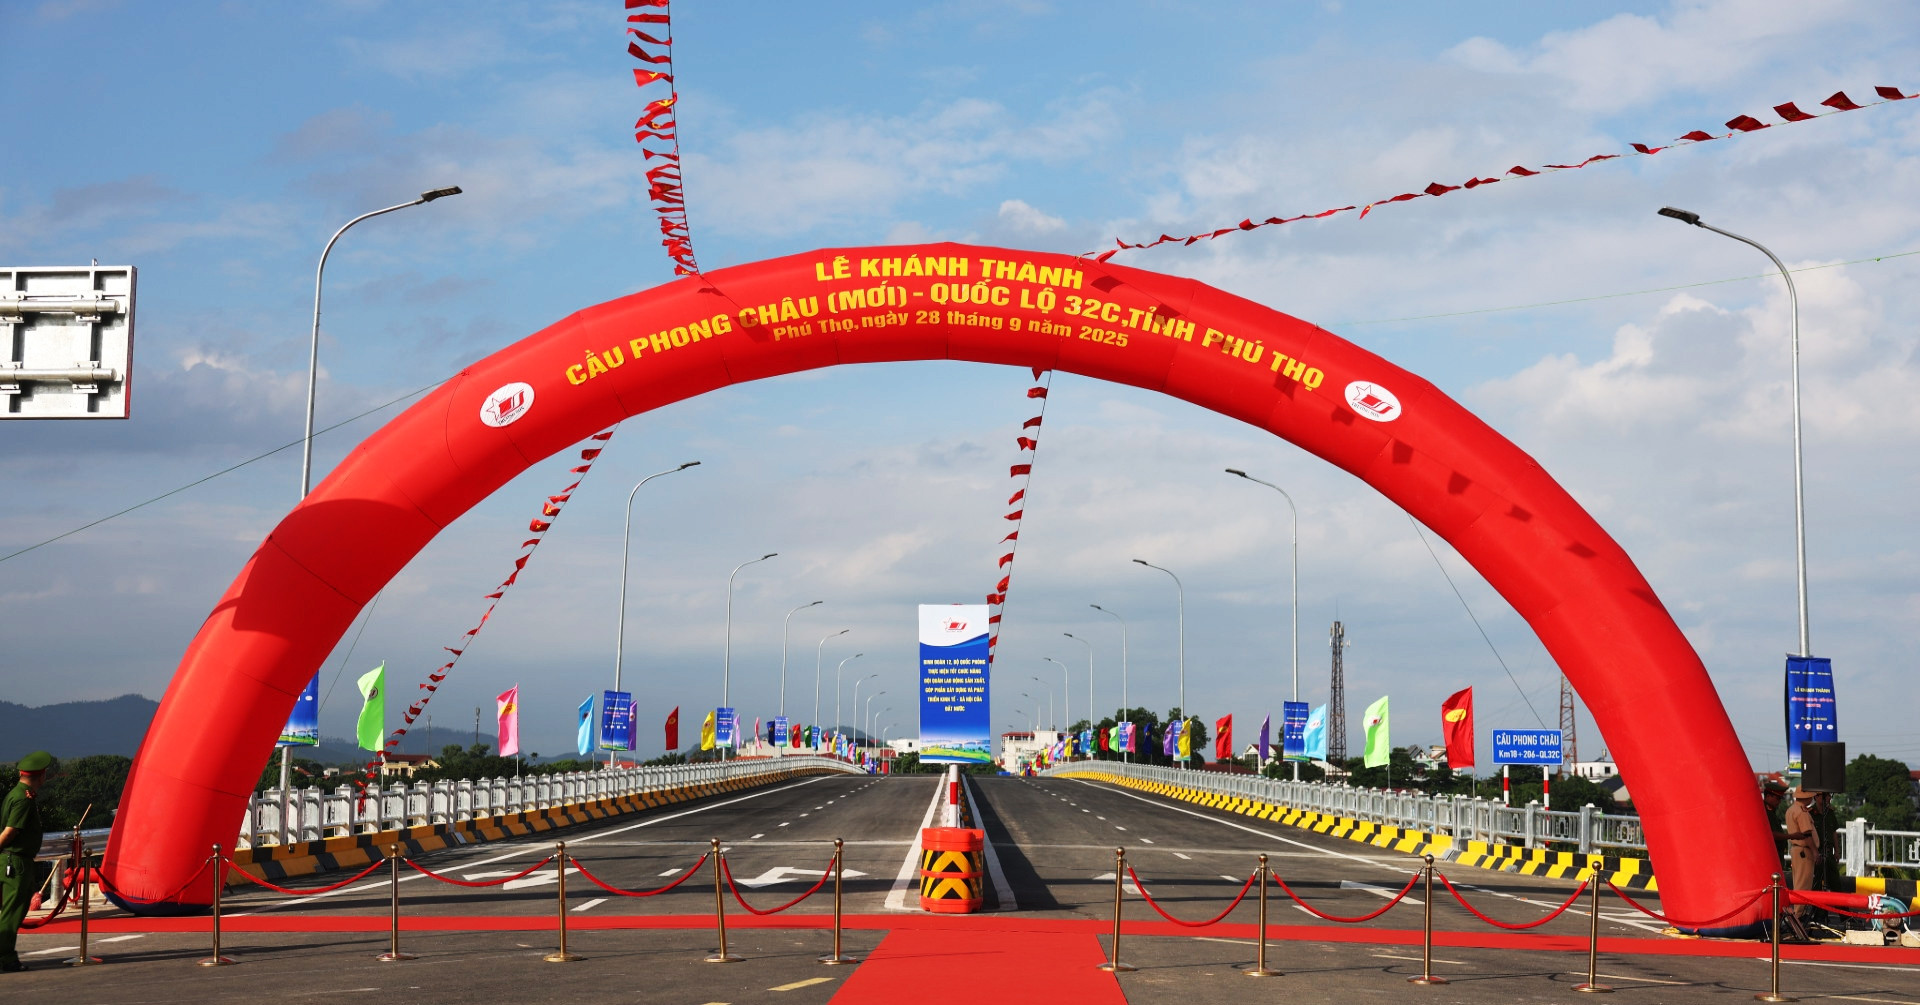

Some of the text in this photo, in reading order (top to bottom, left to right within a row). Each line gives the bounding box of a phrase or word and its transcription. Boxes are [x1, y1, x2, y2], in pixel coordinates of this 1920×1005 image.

[815, 253, 1084, 290] LỄ KHÁNH THÀNH
[565, 345, 625, 386] CẦU
[629, 313, 733, 360] PHONG
[738, 296, 819, 328] CHÂU
[827, 280, 908, 314] (MỚI)
[929, 279, 1010, 305] QUỐC
[1019, 287, 1057, 314] LỘ
[1201, 327, 1265, 364] PHÚ
[1269, 350, 1325, 392] THỌ
[773, 320, 812, 342] Phú
[861, 310, 909, 329] ngày
[915, 310, 941, 325] 28
[946, 310, 1003, 331] tháng
[1009, 317, 1022, 332] 9
[1027, 316, 1072, 338] năm
[1078, 325, 1129, 348] 2025
[1497, 733, 1559, 745] CẦU PHONG CHÂU
